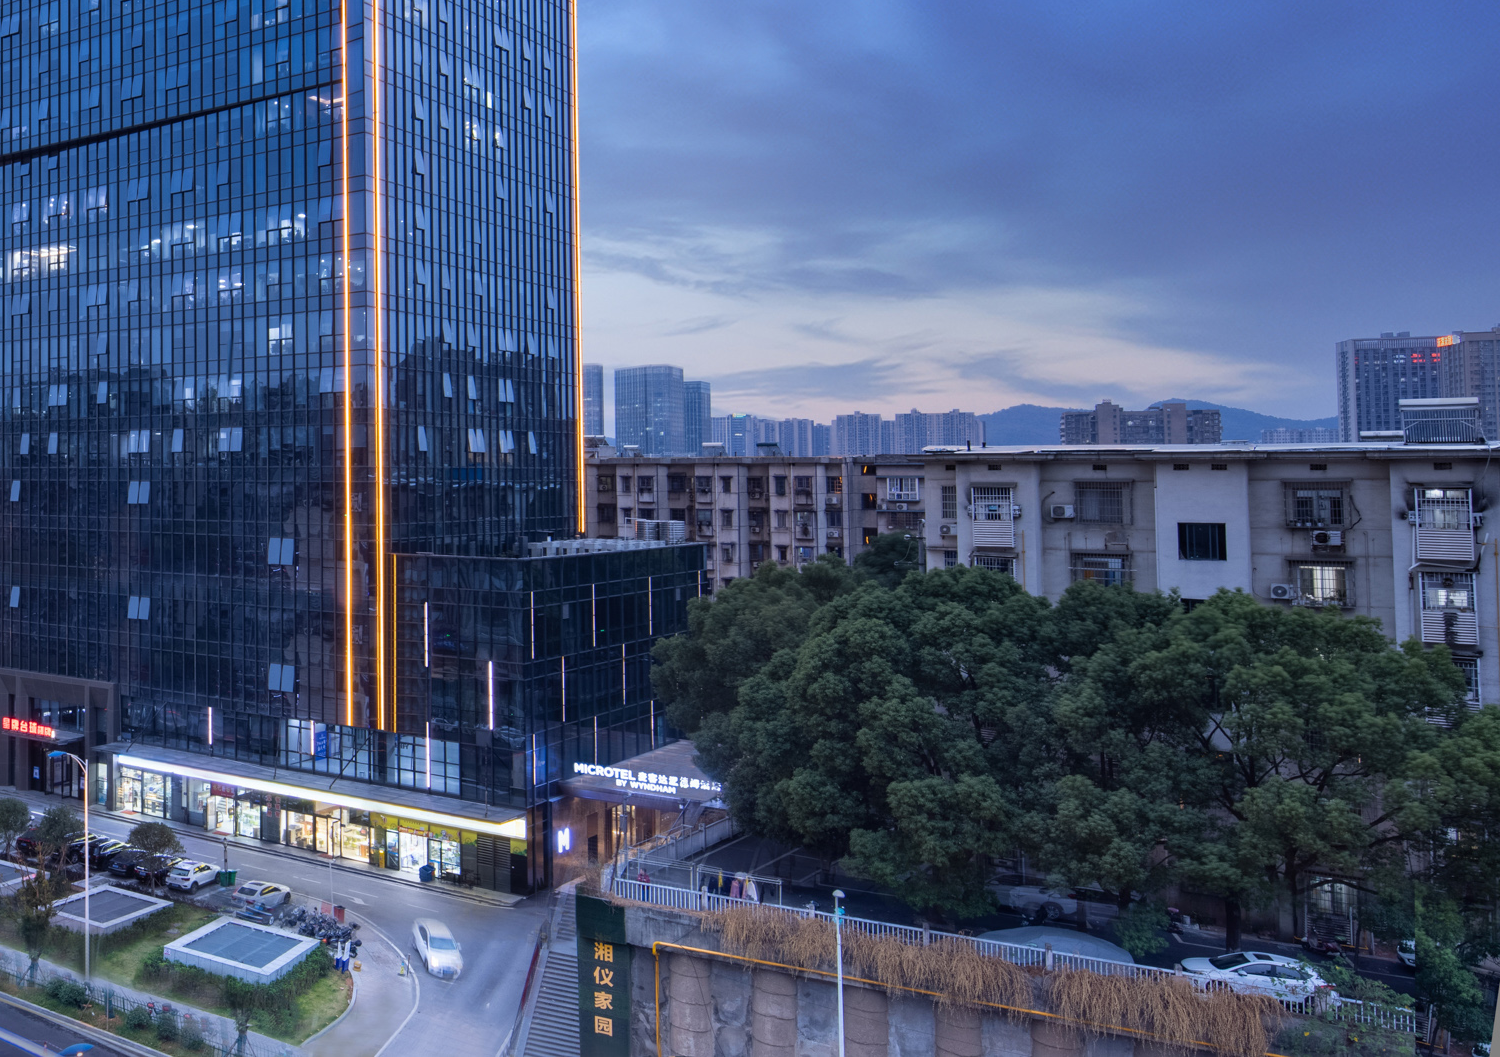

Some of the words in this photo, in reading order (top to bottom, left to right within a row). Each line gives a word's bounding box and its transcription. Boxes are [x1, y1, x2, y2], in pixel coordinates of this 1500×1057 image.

[573, 762, 636, 781] MICROTEL
[615, 778, 627, 788] BY
[630, 779, 677, 795] WYNDHAM
[557, 827, 570, 854] M
[593, 941, 614, 1037] 湘仪家园
